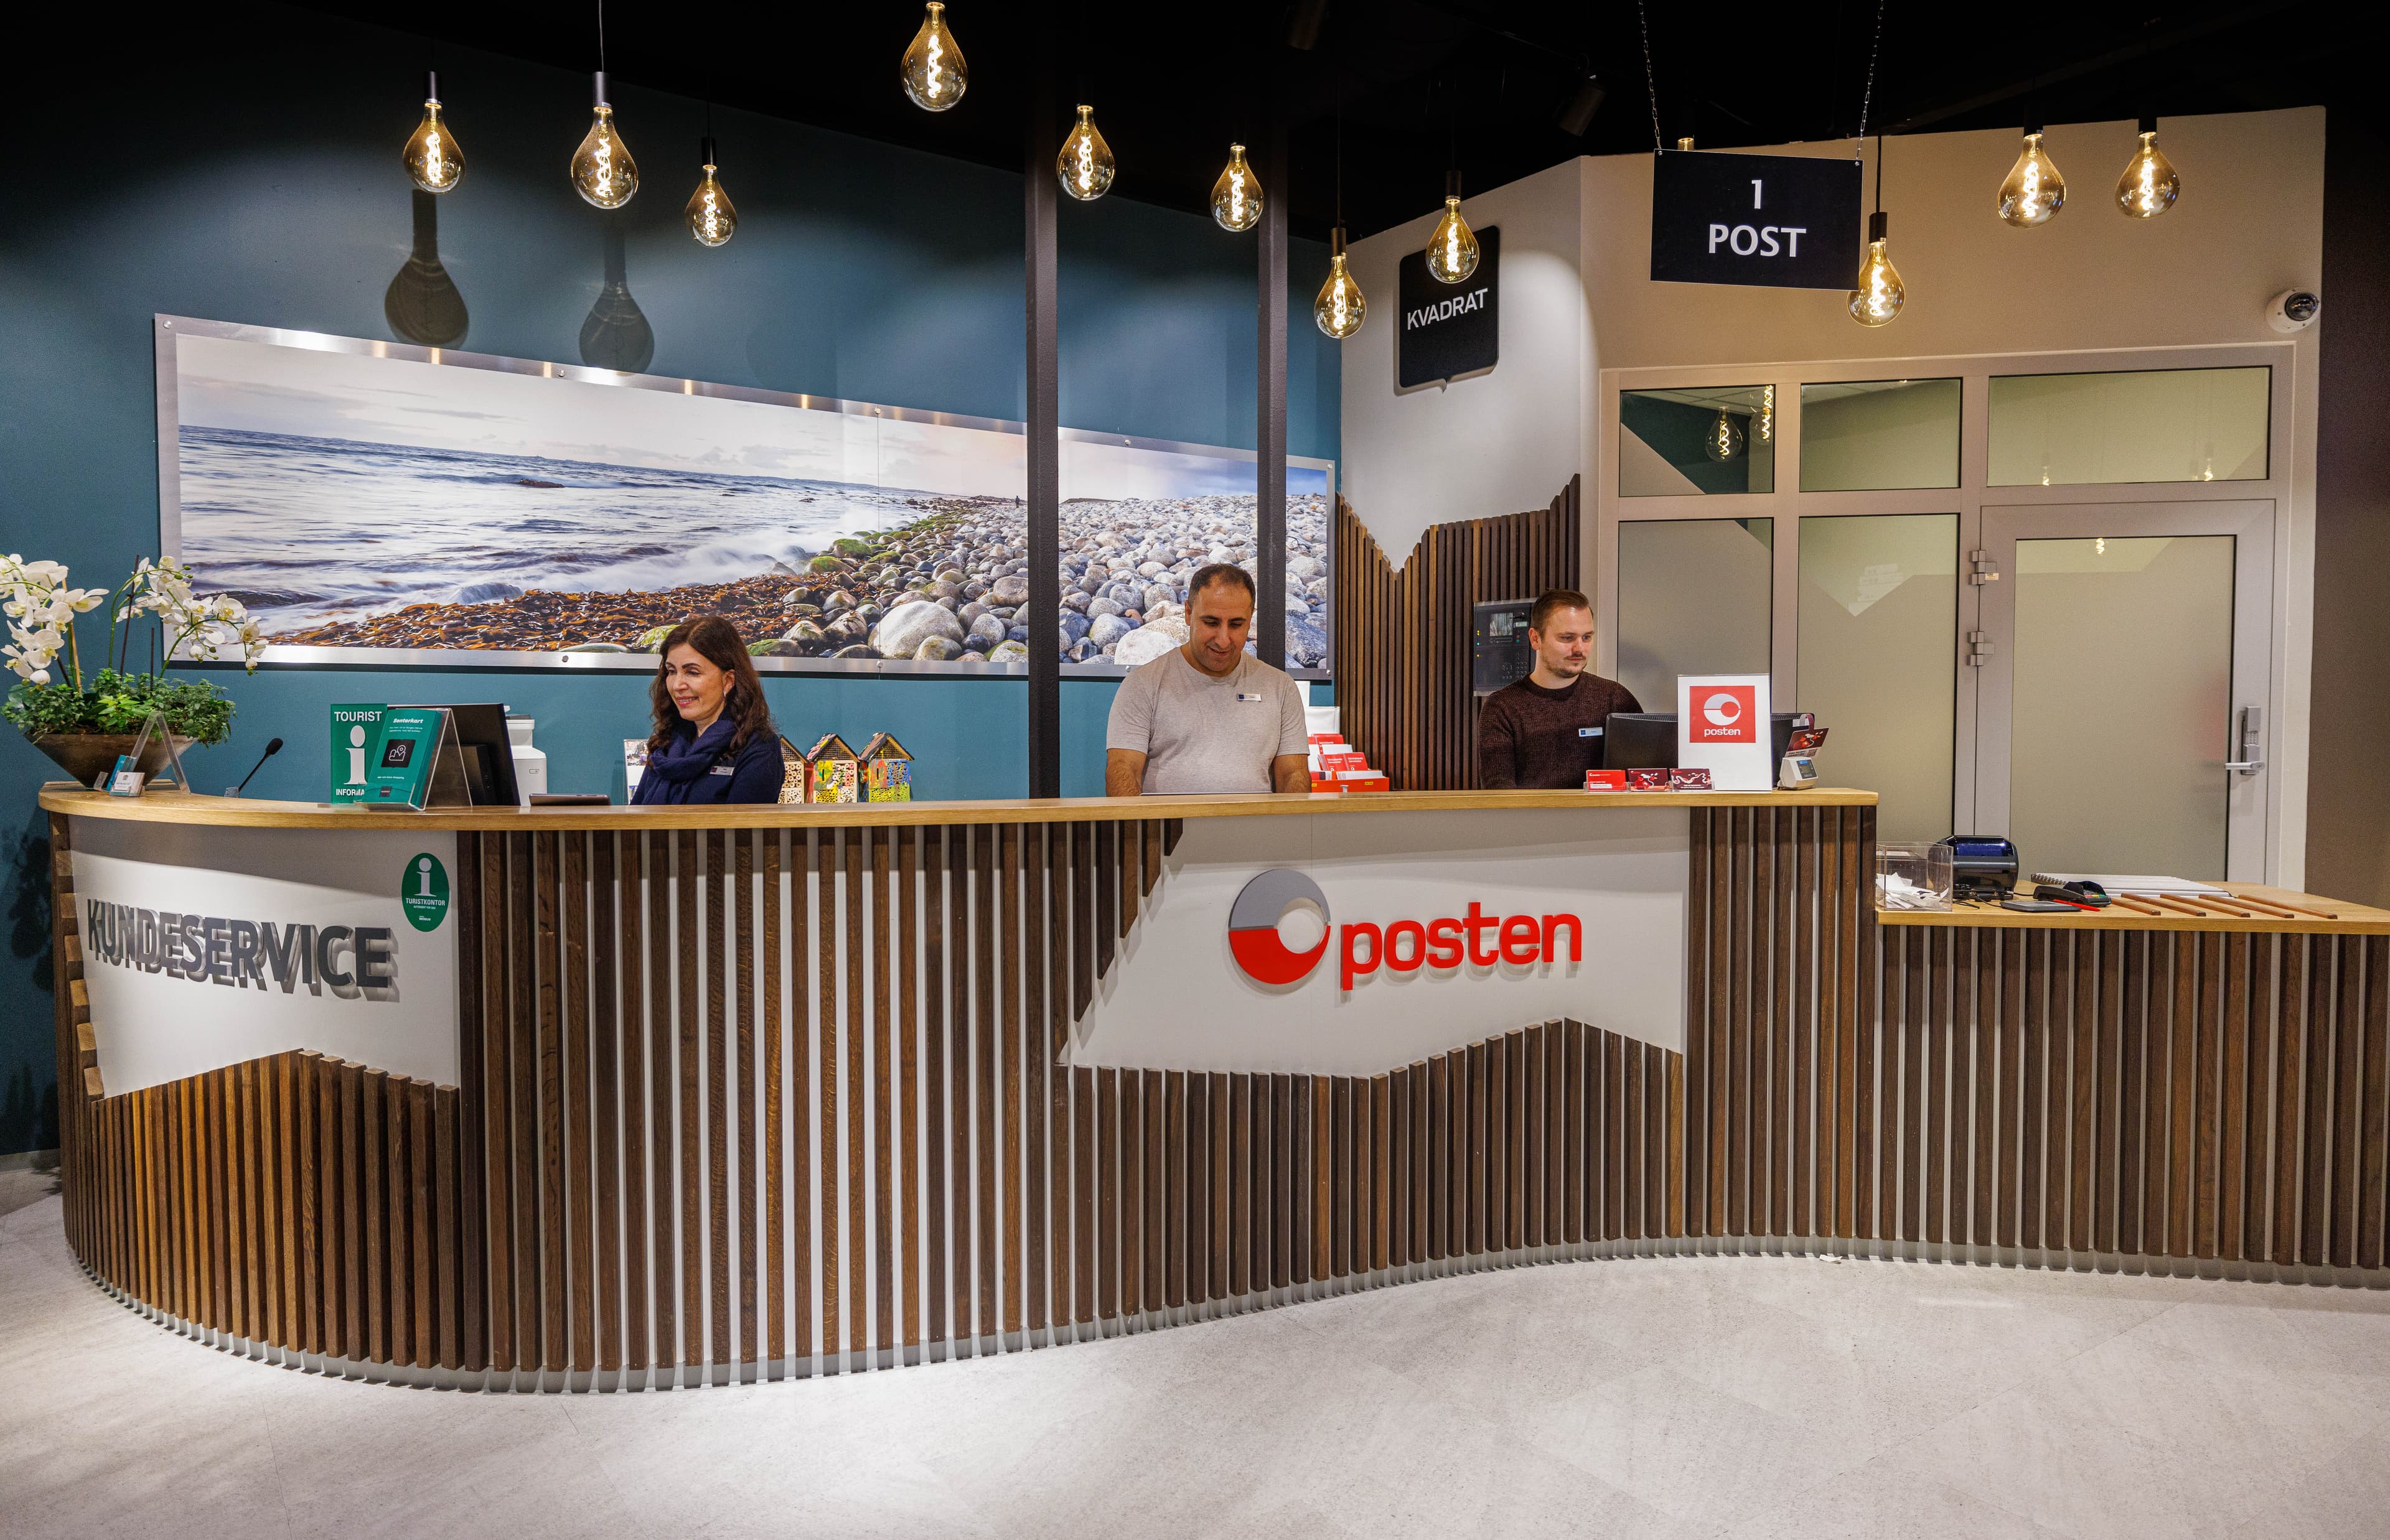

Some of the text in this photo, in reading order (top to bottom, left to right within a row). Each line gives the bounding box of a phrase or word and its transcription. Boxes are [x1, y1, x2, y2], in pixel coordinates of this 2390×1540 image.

[1751, 179, 1762, 210] 1
[1708, 223, 1807, 258] POST
[1407, 287, 1488, 330] KVADRAT
[334, 711, 382, 722] TOURIST
[1703, 727, 1741, 737] posten
[405, 897, 446, 906] TURISTKONTOR
[87, 898, 391, 989] KUNDESERVICE
[1340, 901, 1582, 991] posten
